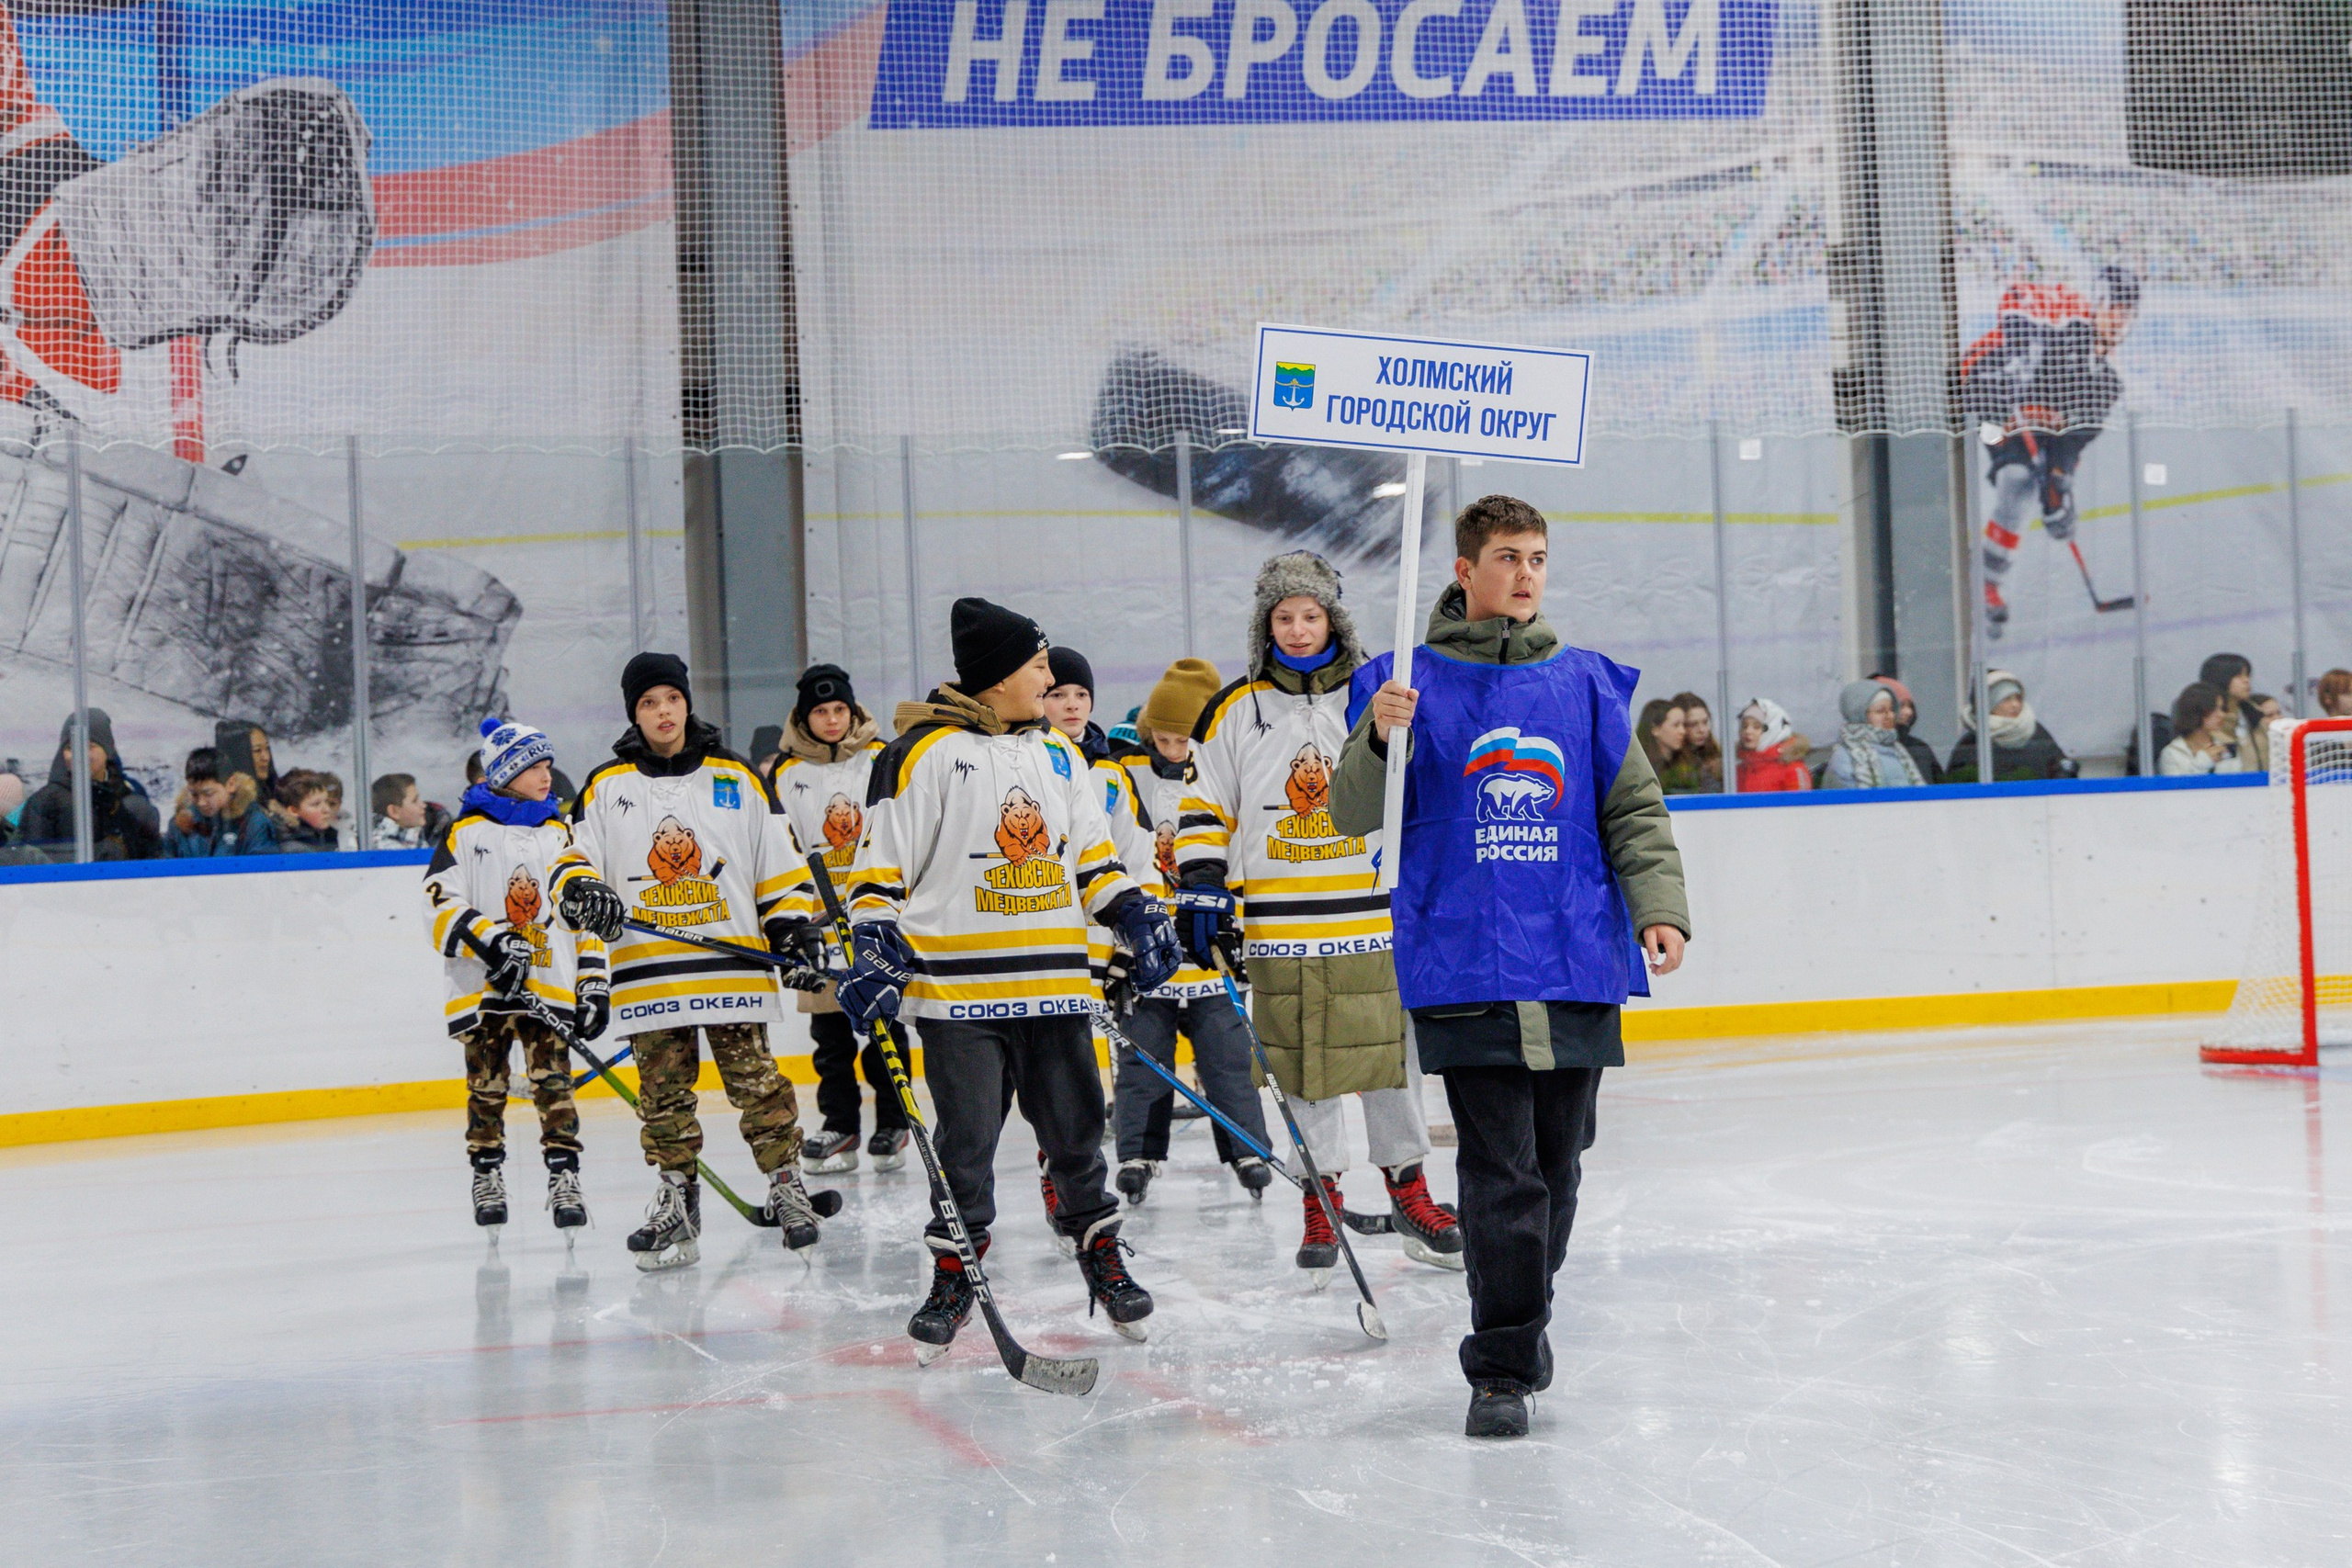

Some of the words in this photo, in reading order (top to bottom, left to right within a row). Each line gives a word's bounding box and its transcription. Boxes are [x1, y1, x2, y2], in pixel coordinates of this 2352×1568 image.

[943, 0, 1103, 101] НЕ
[1142, 0, 1720, 99] БРОСАЕМ
[1375, 355, 1513, 396] ХОЛМСКИЙ
[1326, 394, 1472, 434] ГОРОДСКОЙ
[1479, 407, 1557, 441] ОКРУГ
[1276, 810, 1341, 839] ЧЕХОВСК
[1476, 825, 1558, 844] ЕДИНАЯ
[1267, 834, 1367, 863] МЕДВЕЖАТА
[1476, 843, 1558, 863] РОССИЯ
[984, 858, 1066, 889] ЧЕХОВСКИЕ
[425, 880, 451, 908] 2
[639, 879, 720, 907] ЧЕХОВСКИЕ
[975, 881, 1072, 916] МЕДВЕЖАТА
[632, 897, 731, 928] МЕДВЕЖАТА
[1249, 943, 1307, 956] СОЮЗ
[1318, 936, 1393, 955] ОКЕАН
[620, 1000, 680, 1020] СОЮЗ
[690, 996, 763, 1010] ОКЕАН
[950, 1002, 1028, 1019] СОЮЗ
[1090, 1014, 1131, 1048] AUER
[938, 1200, 989, 1303] BAUER
